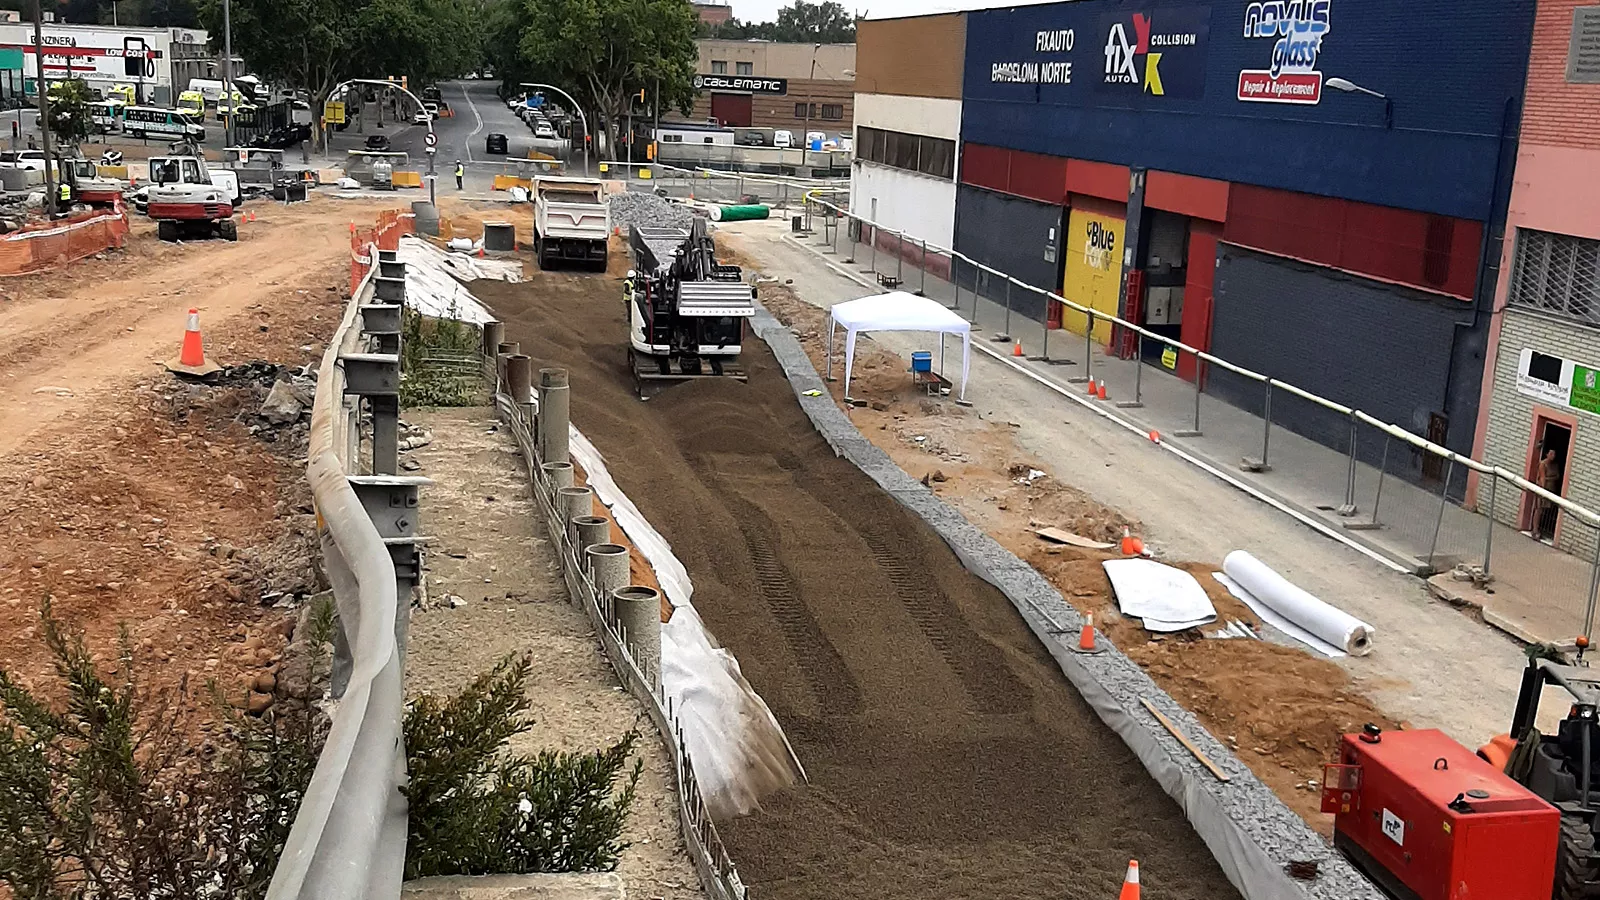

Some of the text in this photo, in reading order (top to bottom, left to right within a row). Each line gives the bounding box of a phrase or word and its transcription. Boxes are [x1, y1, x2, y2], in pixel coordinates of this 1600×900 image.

[30, 35, 76, 46] BNZINERA
[1036, 29, 1074, 51] FIXAUTO
[1151, 34, 1196, 46] COLLISION
[1273, 30, 1317, 77] glass
[992, 62, 1072, 83] BARCELONA NORTE
[1104, 75, 1130, 83] AUTO
[1243, 80, 1265, 96] Repair
[1271, 80, 1315, 98] Replacement
[1091, 221, 1115, 251] Blue
